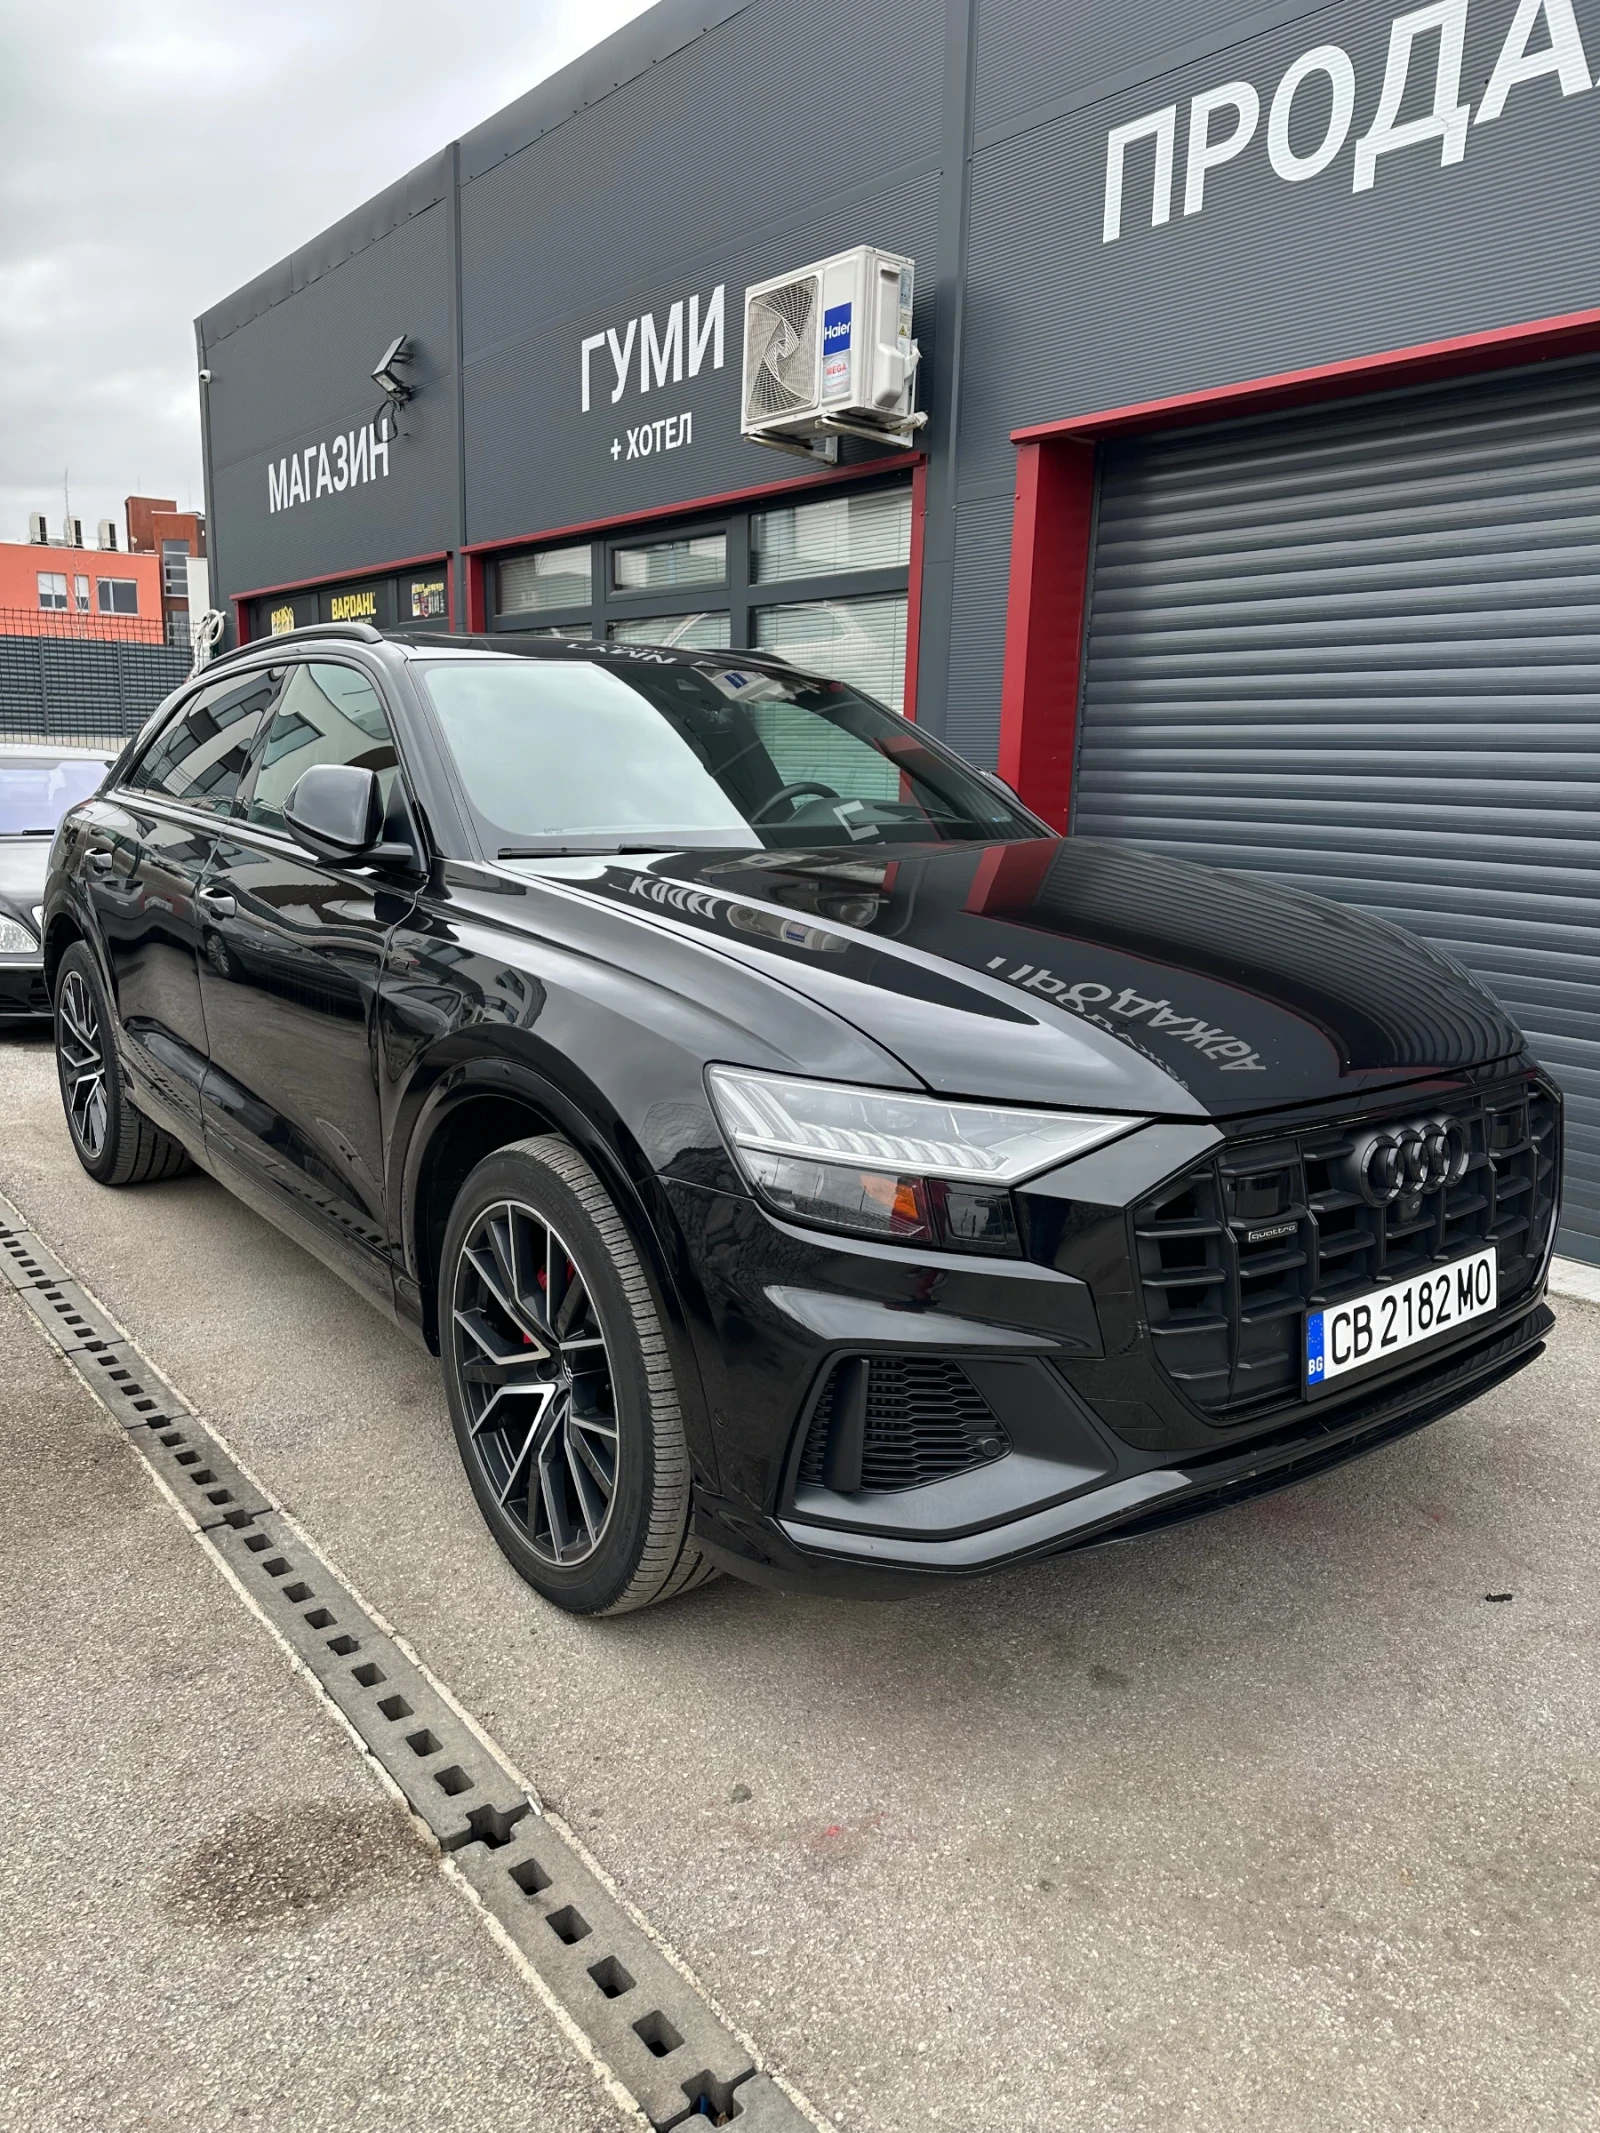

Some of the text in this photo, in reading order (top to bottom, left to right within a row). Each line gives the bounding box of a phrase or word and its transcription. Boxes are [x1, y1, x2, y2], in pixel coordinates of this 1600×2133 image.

[1102, 0, 1600, 243] ПРОДА
[580, 284, 725, 413] ГУМИ
[824, 321, 852, 341] Haier
[826, 363, 847, 376] MEGA
[625, 412, 693, 461] ХОТЕЛ
[268, 418, 390, 513] МАГАЗИН
[331, 591, 377, 620] BARDAHL
[1251, 1225, 1296, 1240] quattro
[1331, 1259, 1491, 1365] CB 2182 MO
[1308, 1356, 1324, 1376] BG
